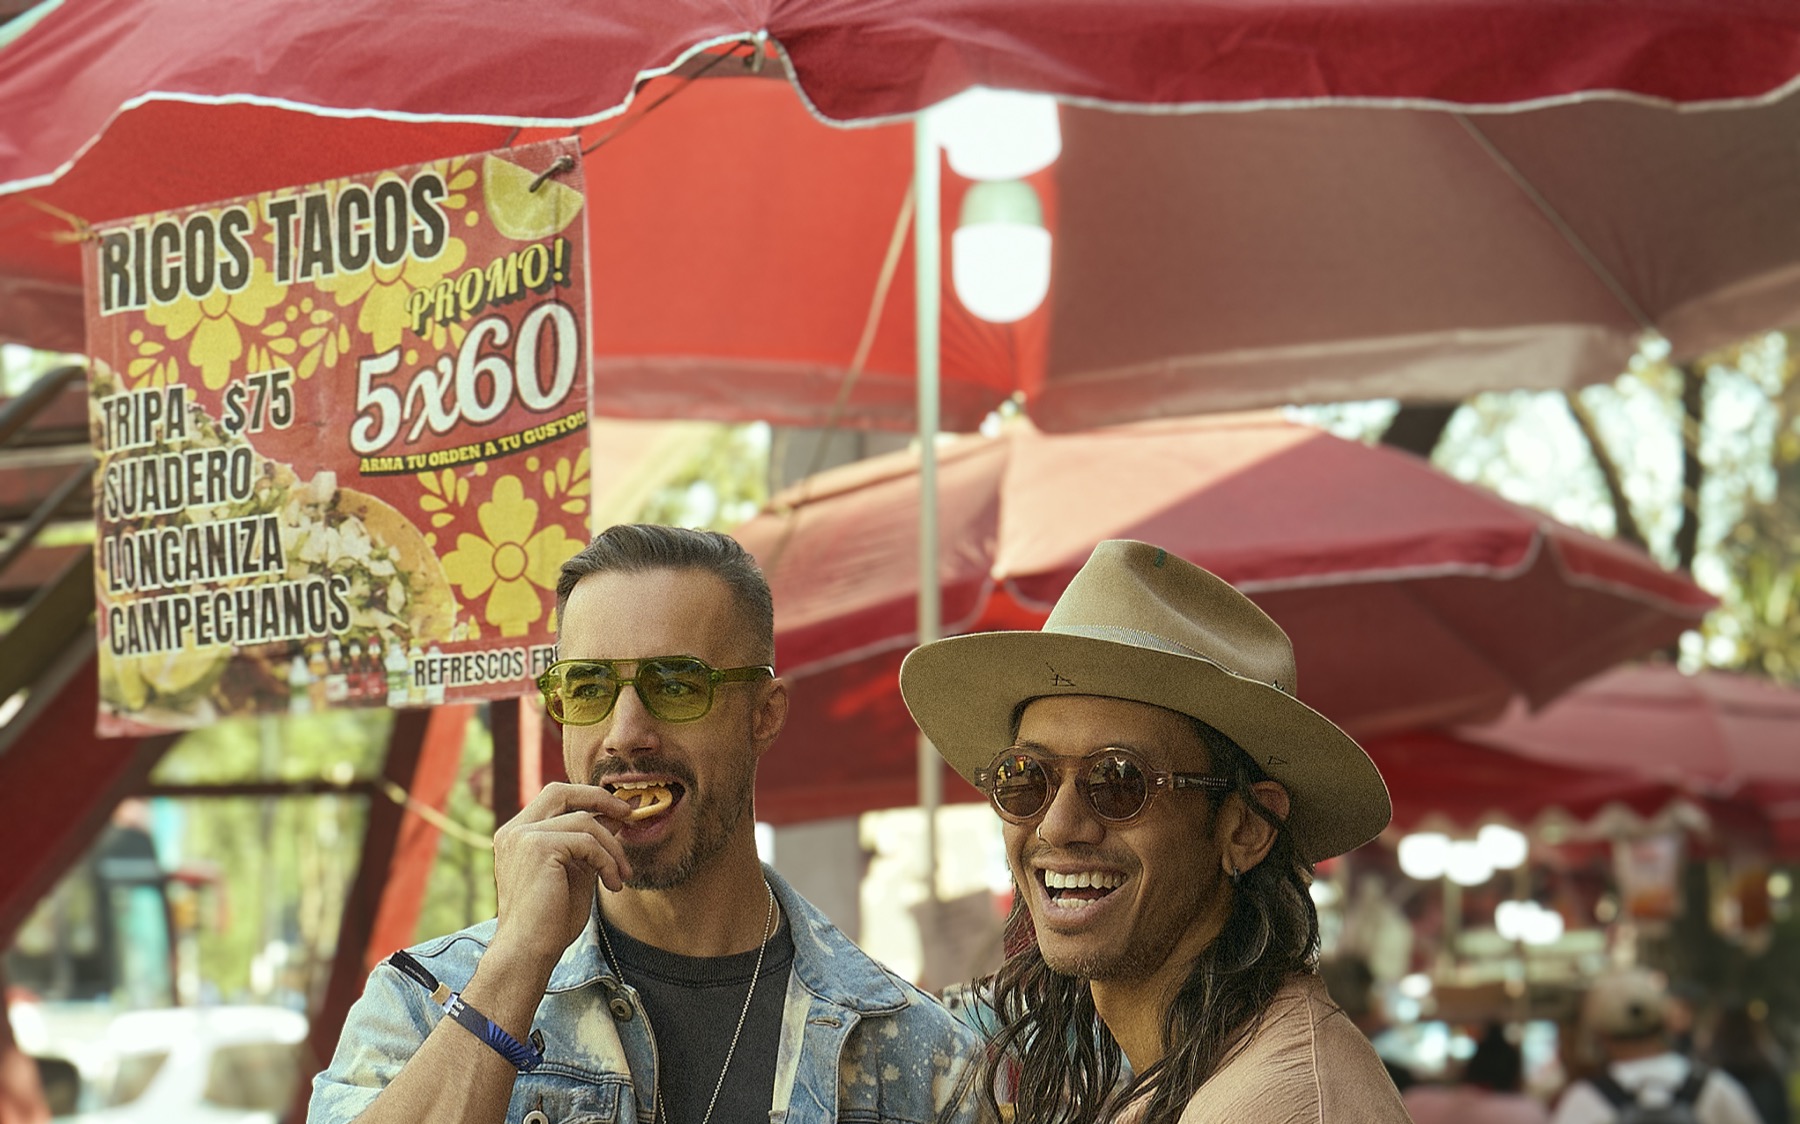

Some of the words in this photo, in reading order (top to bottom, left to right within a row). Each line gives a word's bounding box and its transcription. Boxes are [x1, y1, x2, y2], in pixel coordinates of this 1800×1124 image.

[102, 208, 250, 313] RICOS
[269, 172, 446, 283] TACOS
[406, 239, 571, 334] PROMO!
[102, 387, 186, 451] TRIPA
[223, 371, 293, 434] $75
[349, 302, 579, 455] 5x60
[360, 457, 404, 473] ARMA
[406, 453, 427, 470] TU
[428, 444, 482, 467] ORDEN
[484, 442, 498, 457] A
[498, 434, 522, 452] TU
[523, 410, 588, 446] GUSTO!!
[104, 447, 254, 521] SUADERO
[106, 517, 285, 593] LONGANIZA
[109, 577, 350, 657] CAMPECHANOS
[414, 651, 523, 687] REFRESCOS
